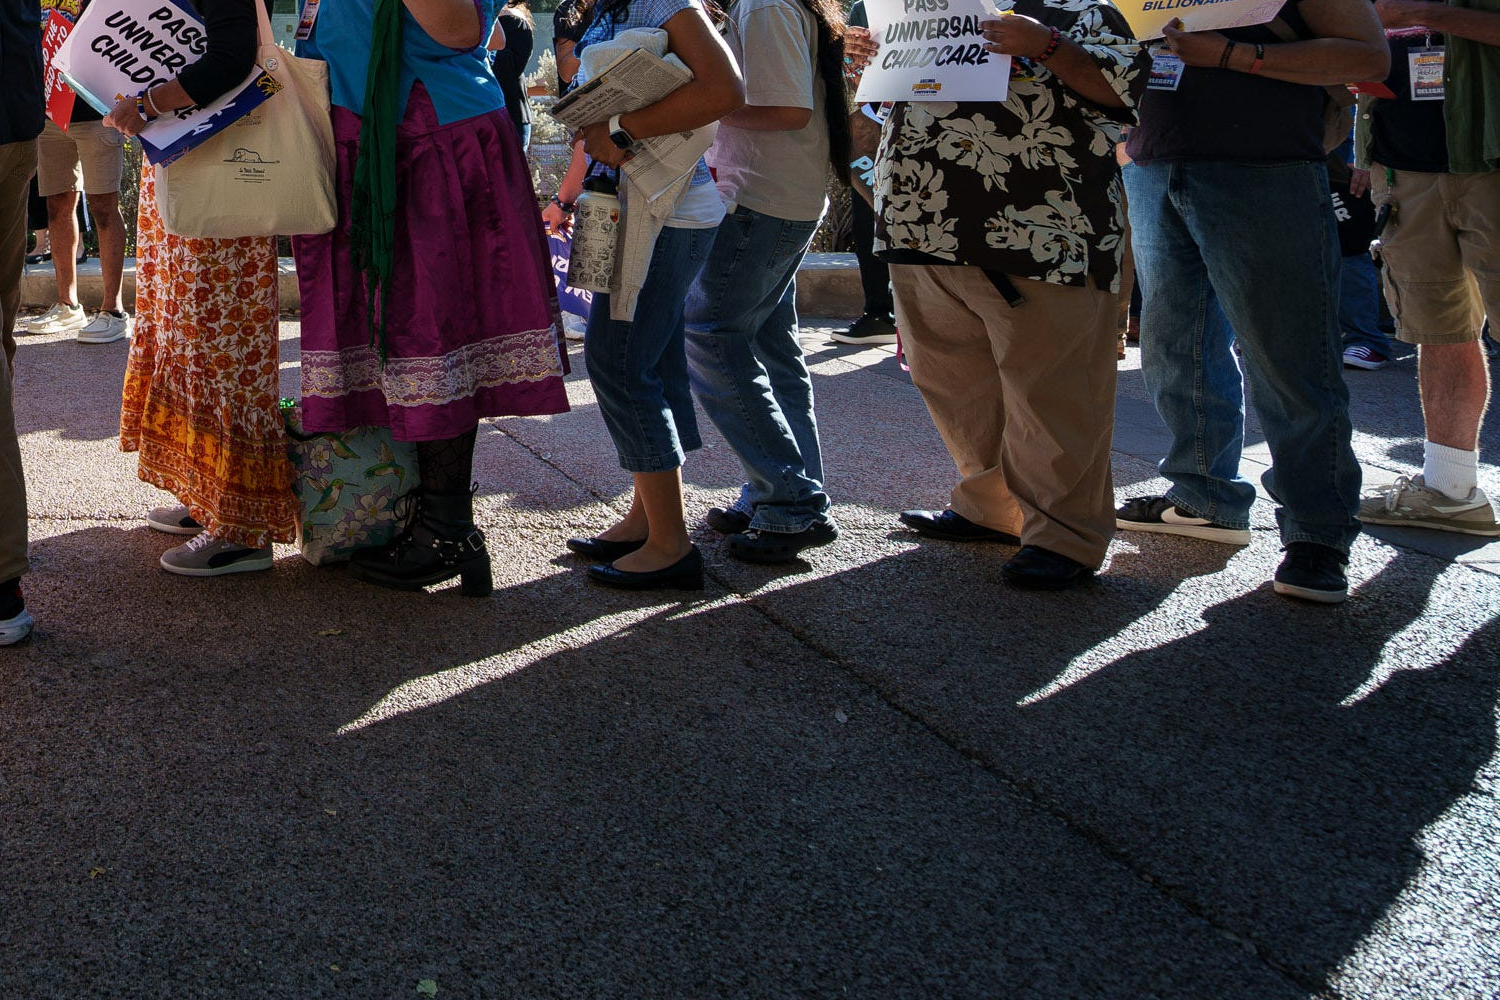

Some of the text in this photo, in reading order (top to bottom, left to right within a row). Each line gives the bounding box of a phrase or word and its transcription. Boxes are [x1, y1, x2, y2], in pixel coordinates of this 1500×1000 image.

[104, 10, 188, 75] UNIVER
[148, 6, 208, 55] PASS
[885, 14, 985, 45] UNIVERSAL
[881, 42, 993, 71] CHILDCARE
